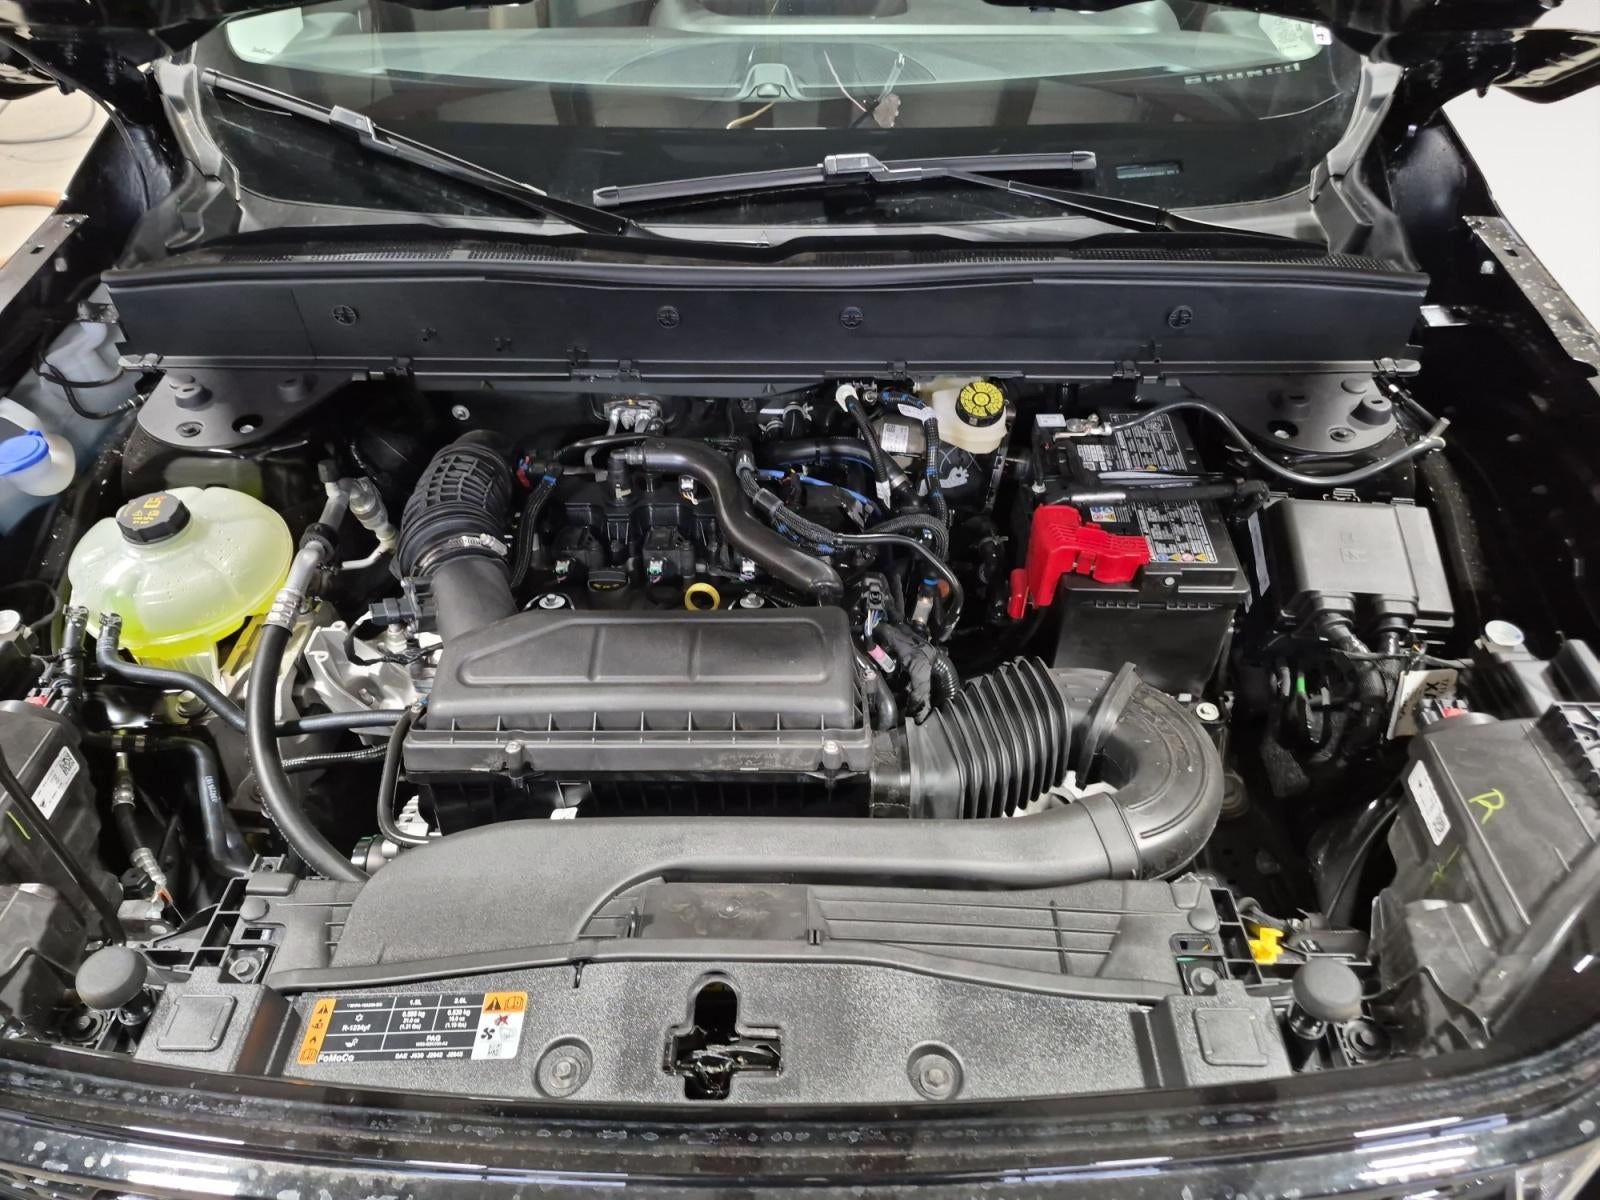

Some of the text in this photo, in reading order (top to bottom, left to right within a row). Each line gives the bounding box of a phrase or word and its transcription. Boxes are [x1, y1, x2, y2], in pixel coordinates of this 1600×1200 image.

[1468, 788, 1504, 825] R
[342, 1024, 371, 1032] R-1234yf
[317, 1053, 355, 1063] FoMoCo
